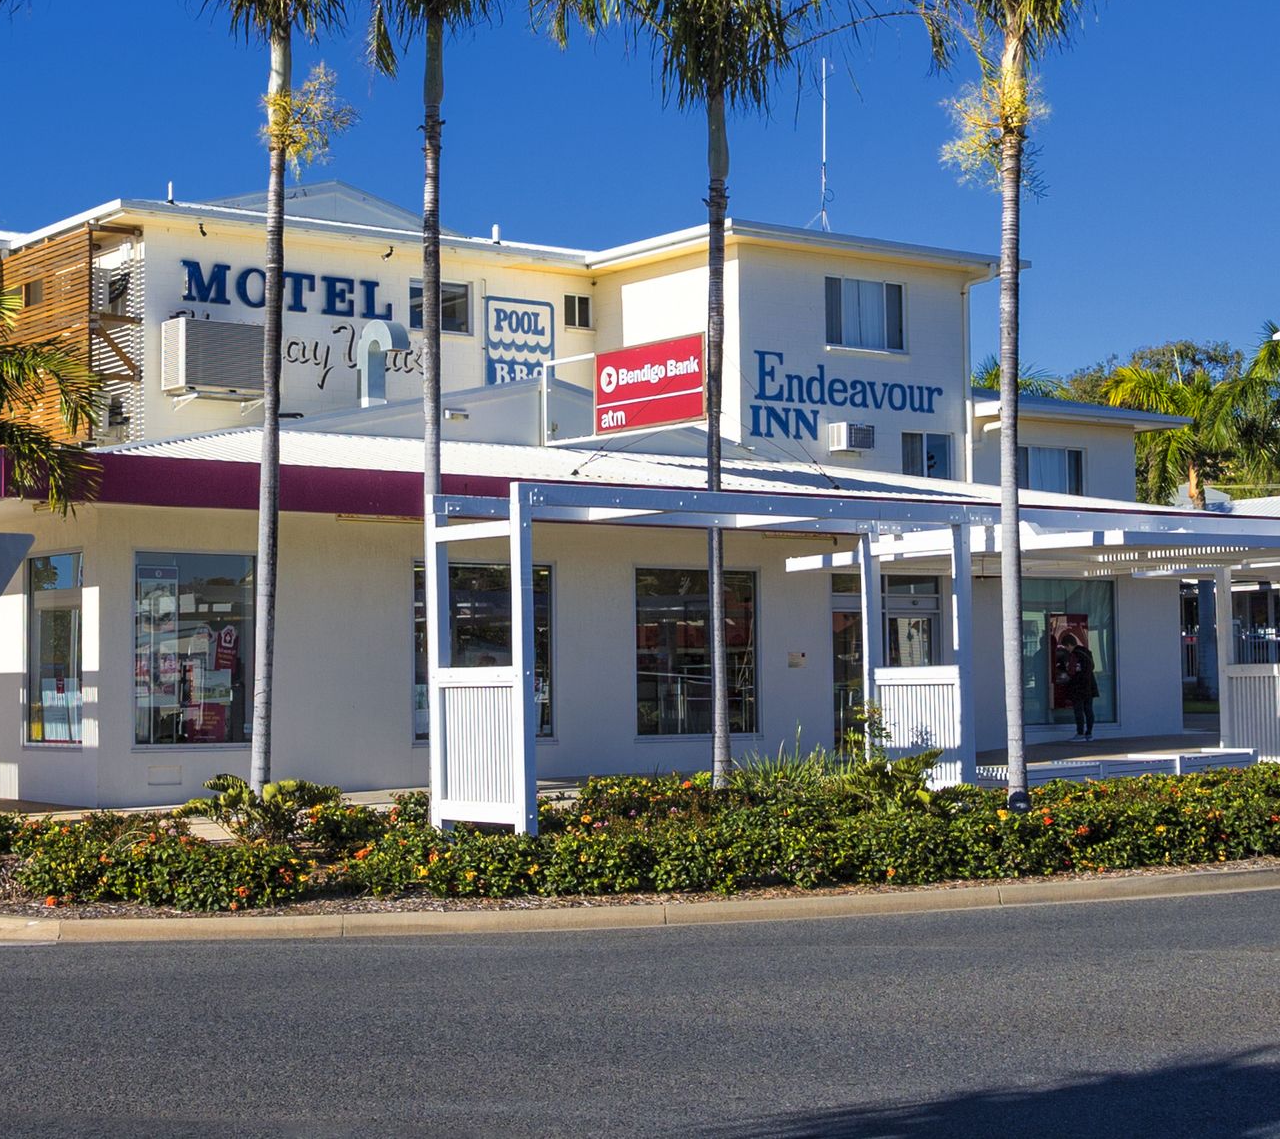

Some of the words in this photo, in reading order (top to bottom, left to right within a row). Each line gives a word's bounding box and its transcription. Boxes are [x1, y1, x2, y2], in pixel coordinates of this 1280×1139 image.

[180, 259, 393, 322] MOTEL
[494, 308, 546, 336] POOL
[619, 364, 666, 386] Bendigo
[666, 356, 699, 377] Bank
[753, 350, 943, 414] Endeavour
[601, 410, 626, 429] atm
[749, 404, 819, 441] INN
